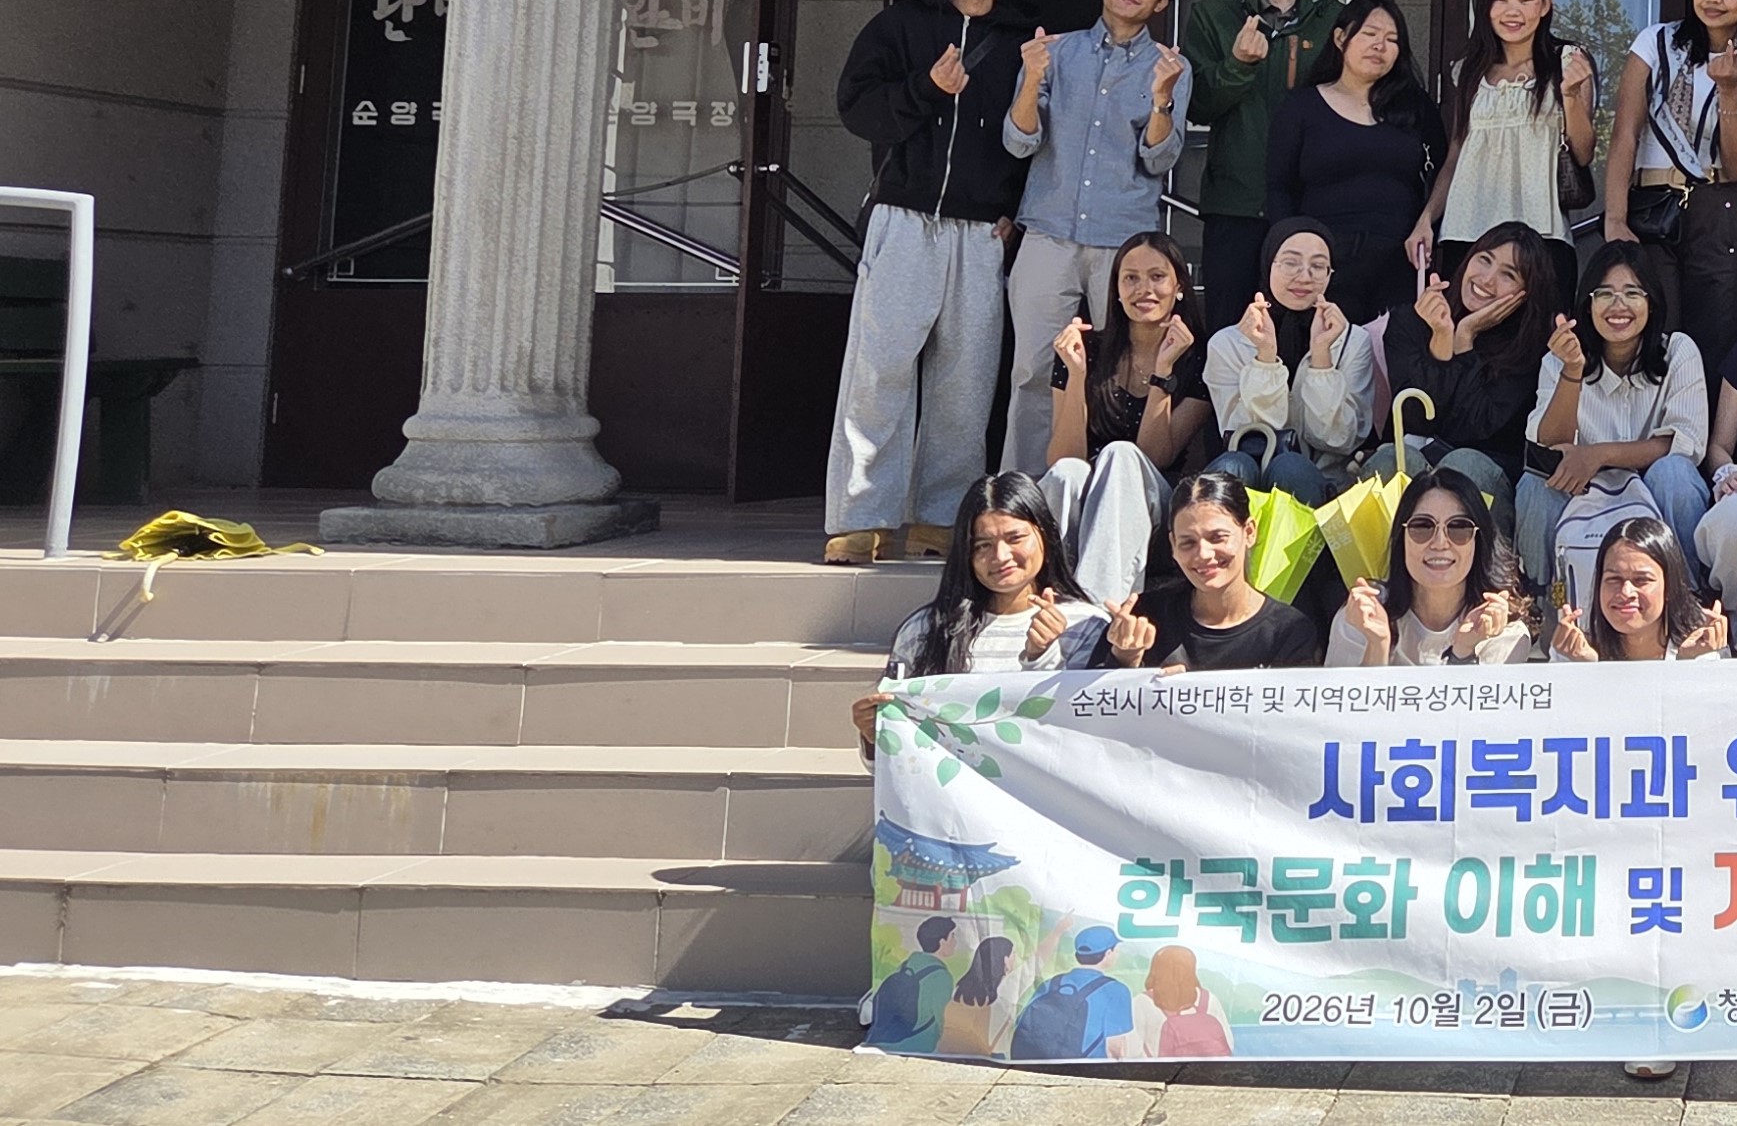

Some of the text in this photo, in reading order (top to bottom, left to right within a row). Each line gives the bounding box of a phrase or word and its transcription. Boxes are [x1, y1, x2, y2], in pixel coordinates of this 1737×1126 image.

[1071, 681, 1554, 717] 순천시 지방대학 및 지역인재육성지원사업
[1308, 734, 1697, 824] 사회복지과
[1115, 855, 1417, 945] 한국문화
[1443, 853, 1597, 938] 이해
[1627, 867, 1683, 937] 및
[1261, 991, 1374, 1027] 2026년
[1393, 993, 1461, 1028] 10월
